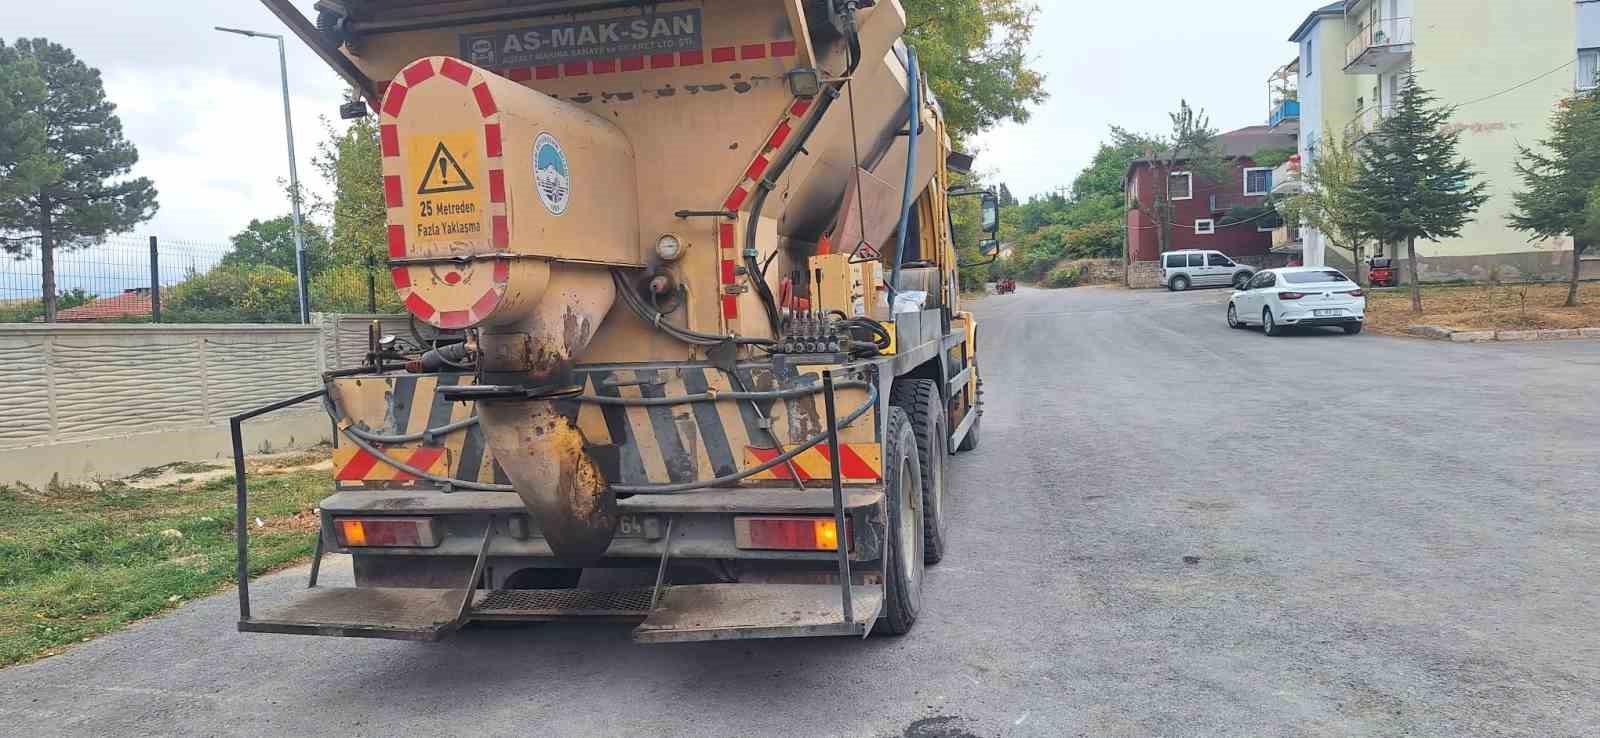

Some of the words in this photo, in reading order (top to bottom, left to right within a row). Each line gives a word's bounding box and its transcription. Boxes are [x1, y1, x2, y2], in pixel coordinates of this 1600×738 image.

[504, 15, 694, 54] AS-MAK-SAN
[420, 200, 433, 217] 25
[436, 202, 476, 216] Metreden
[417, 223, 441, 237] Fazla
